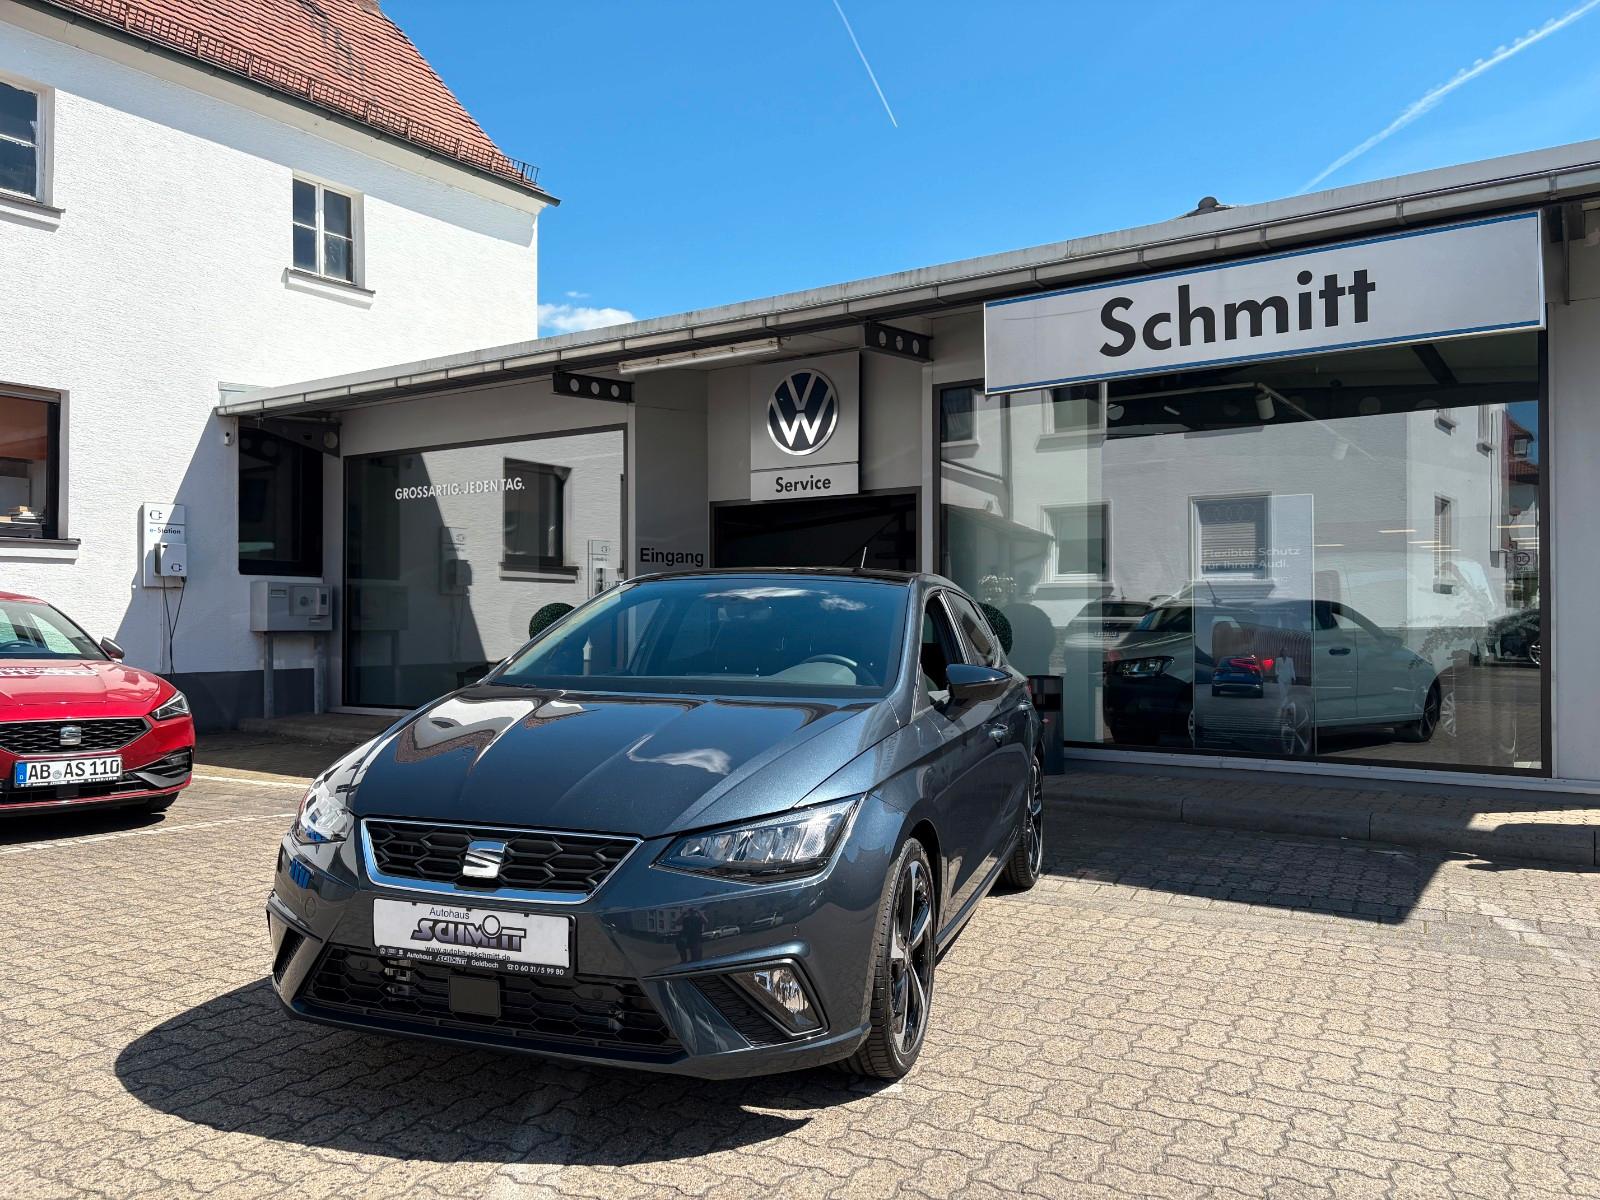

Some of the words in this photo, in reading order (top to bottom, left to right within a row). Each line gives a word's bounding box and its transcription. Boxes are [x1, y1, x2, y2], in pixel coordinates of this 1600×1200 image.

[1099, 269, 1376, 357] Schmitt
[394, 483, 462, 500] GROSSARTIG.
[462, 479, 498, 494] JEDEN
[501, 477, 525, 491] TAG.
[775, 475, 832, 493] Service
[640, 547, 704, 567] Eingang
[1257, 547, 1301, 556] Schutz
[1223, 560, 1255, 569] Ihren
[1257, 559, 1289, 569] Audi.
[28, 764, 50, 780] AB
[64, 762, 86, 778] AS
[90, 760, 119, 776] 110
[429, 906, 470, 920] Autohaus
[410, 914, 527, 952] SCHMITT
[406, 951, 433, 961] Autohaus
[471, 959, 499, 969] Goldbach
